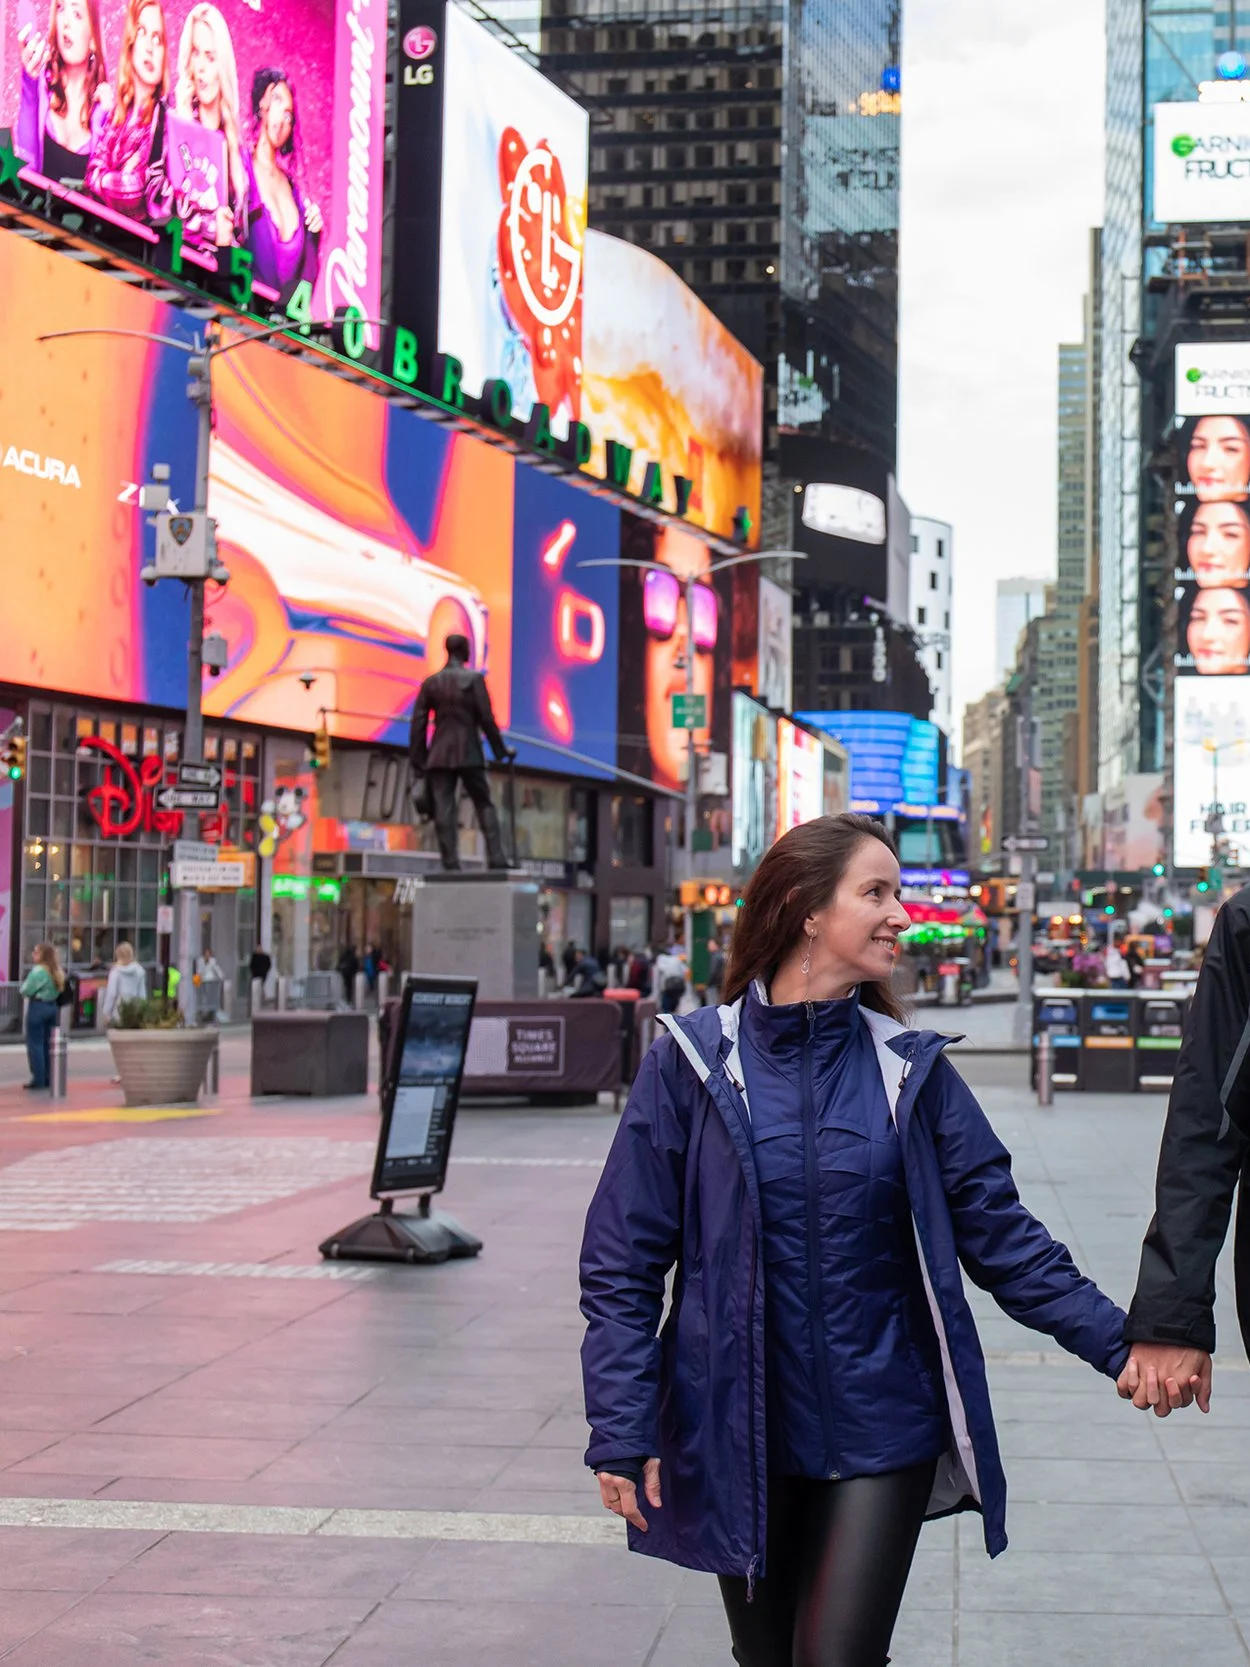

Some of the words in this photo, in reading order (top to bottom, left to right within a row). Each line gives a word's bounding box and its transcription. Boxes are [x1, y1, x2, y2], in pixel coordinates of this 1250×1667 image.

[403, 64, 434, 86] LG
[392, 325, 694, 518] BROADWAY
[3, 445, 82, 489] ACURA
[516, 1029, 554, 1040] TIMES
[511, 1041, 556, 1054] SQUARE
